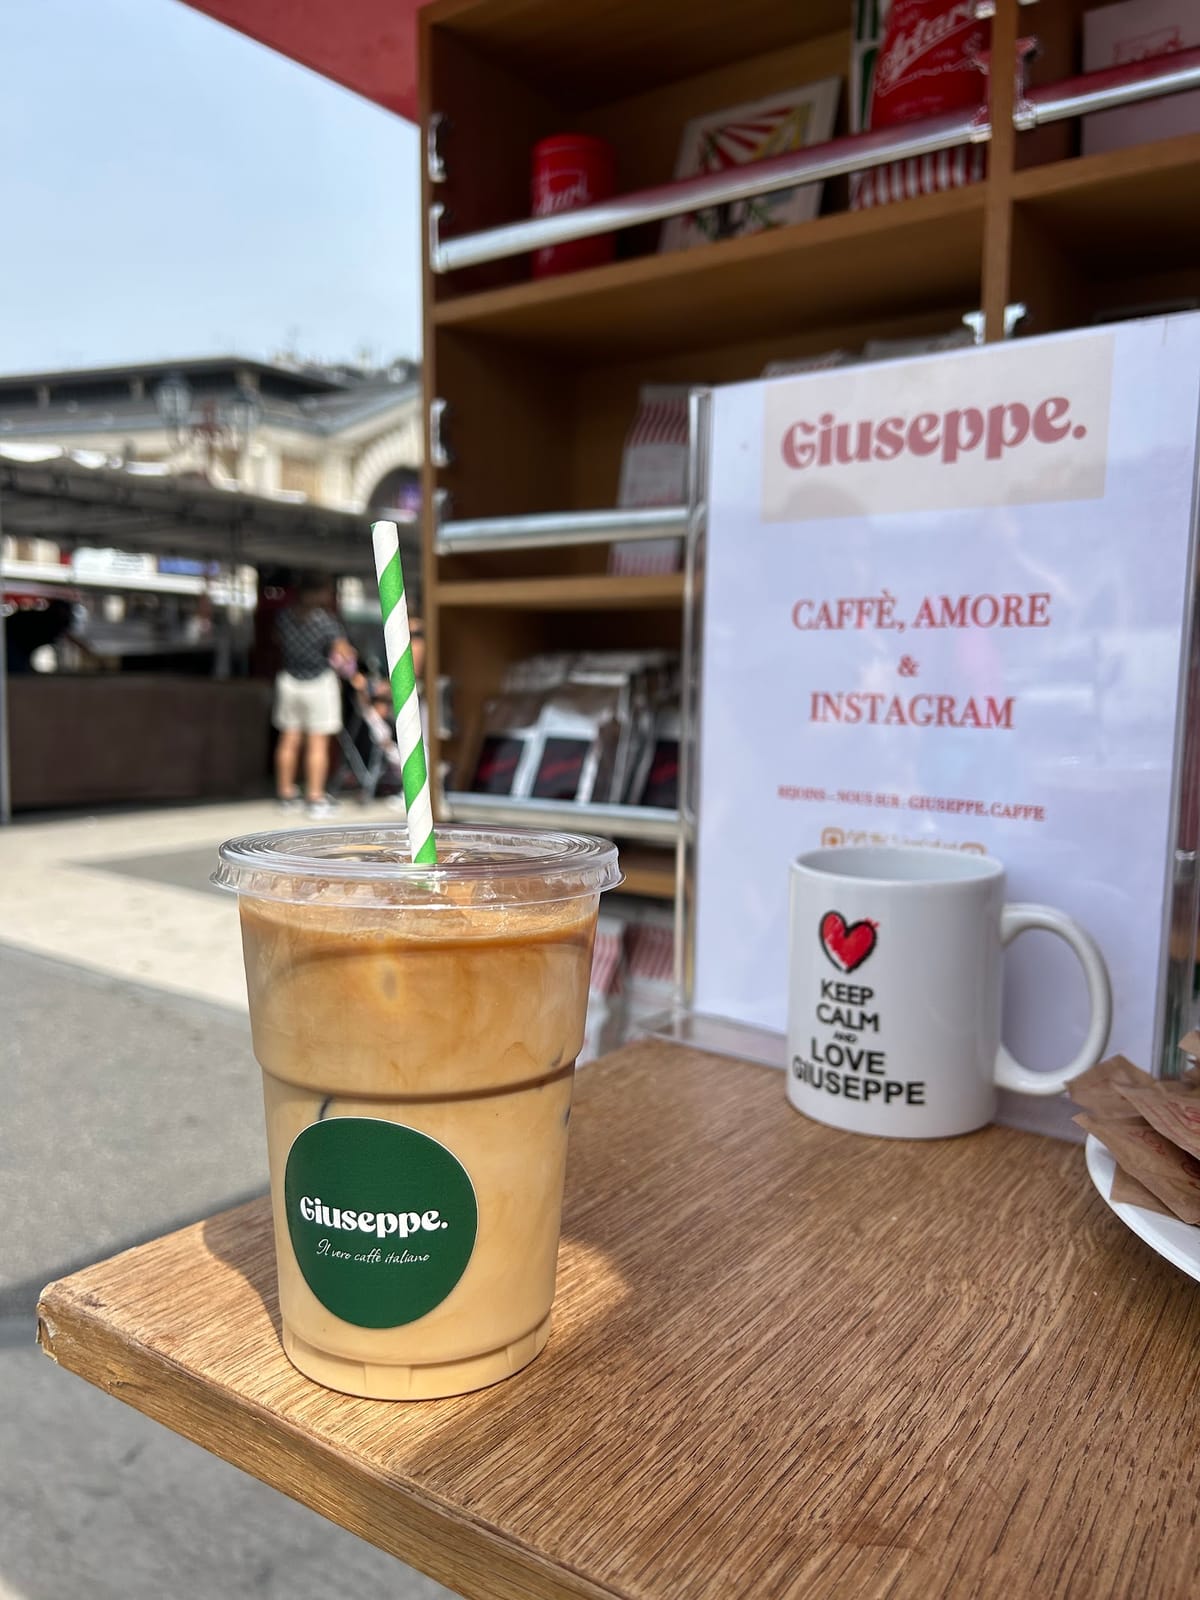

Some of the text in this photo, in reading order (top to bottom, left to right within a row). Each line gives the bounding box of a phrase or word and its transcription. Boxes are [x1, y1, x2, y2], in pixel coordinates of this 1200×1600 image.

[781, 396, 1087, 469] Giuseppe.
[791, 589, 1052, 632] CAFFÈ, AMORE
[897, 654, 919, 677] &
[809, 692, 1016, 729] INSTAGRAM
[820, 979, 875, 1006] KEEP
[816, 1002, 880, 1033] CALM
[811, 1037, 886, 1076] LOVE
[792, 1055, 927, 1106] GIUSEPPE
[300, 1196, 448, 1238] Giuseppe.
[316, 1238, 331, 1256] Il
[331, 1249, 352, 1260] vero
[384, 1249, 430, 1264] italiano
